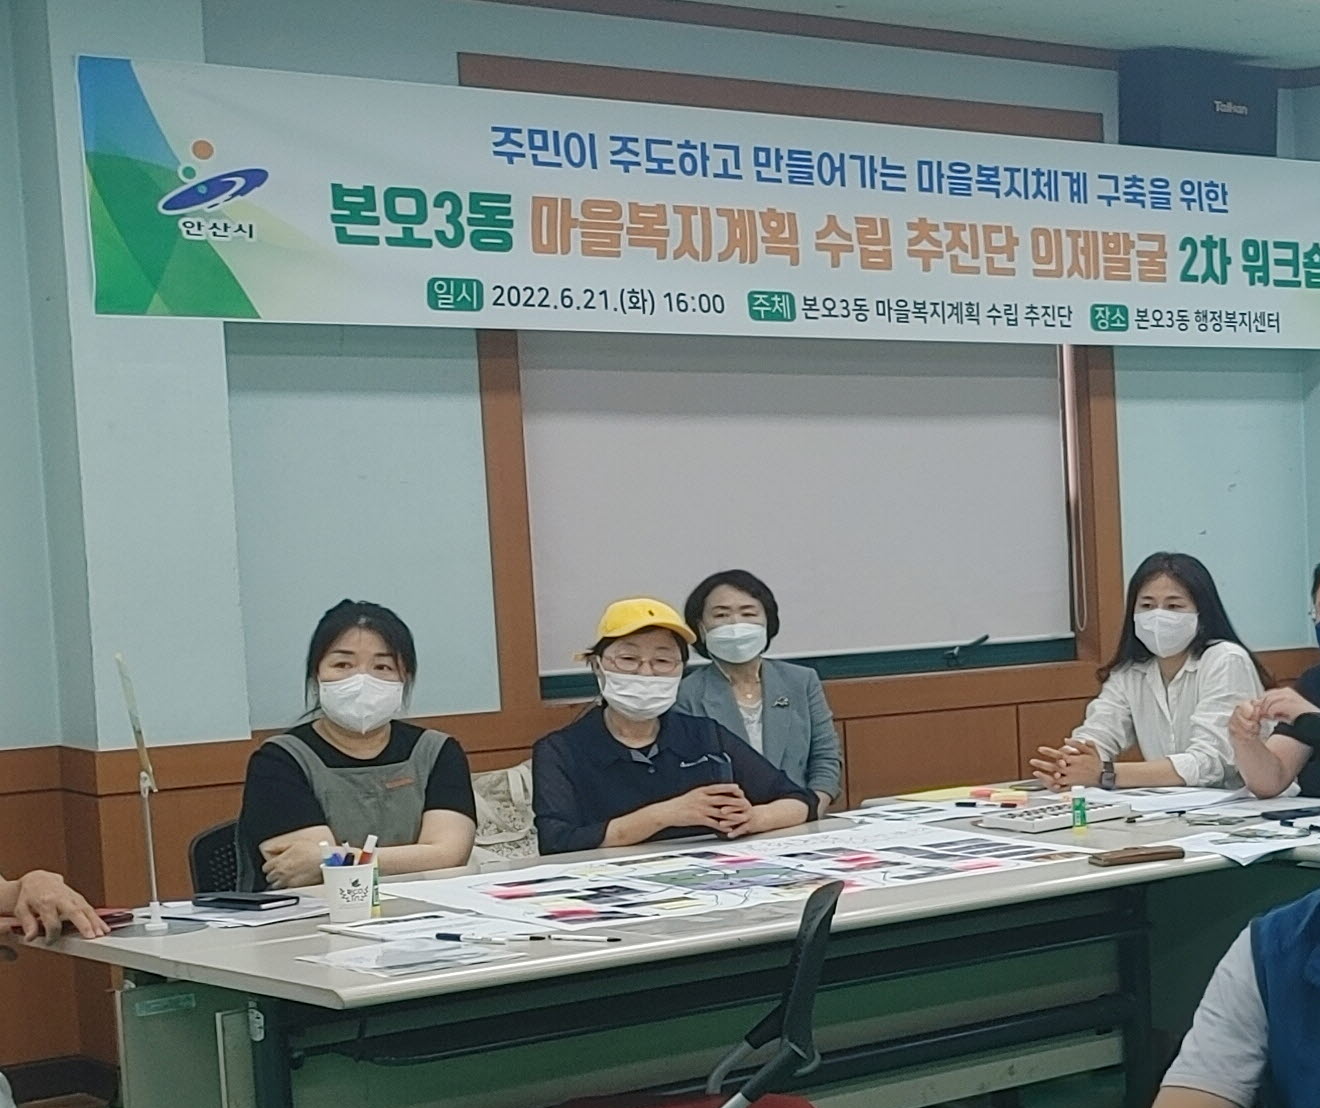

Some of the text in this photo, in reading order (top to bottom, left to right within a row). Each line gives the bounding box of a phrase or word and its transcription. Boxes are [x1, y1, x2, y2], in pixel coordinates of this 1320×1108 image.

[490, 125, 1229, 214] 주민이 주도하고 만들어가는 마을복지체계 구축을 위한
[181, 219, 254, 239] 안산시
[329, 182, 515, 253] 본오3동
[531, 195, 800, 267] 마을복지계획
[814, 212, 893, 271] 수립
[905, 216, 1020, 278] 추진단
[1030, 226, 1168, 284] 의제발굴
[1178, 234, 1232, 286] 2차
[433, 280, 1281, 334] 일시 2022.6.21.(화) 16:00 주체 본오3동 마을복지계획 수립 추진단 장소 본오3동 행정복지센터
